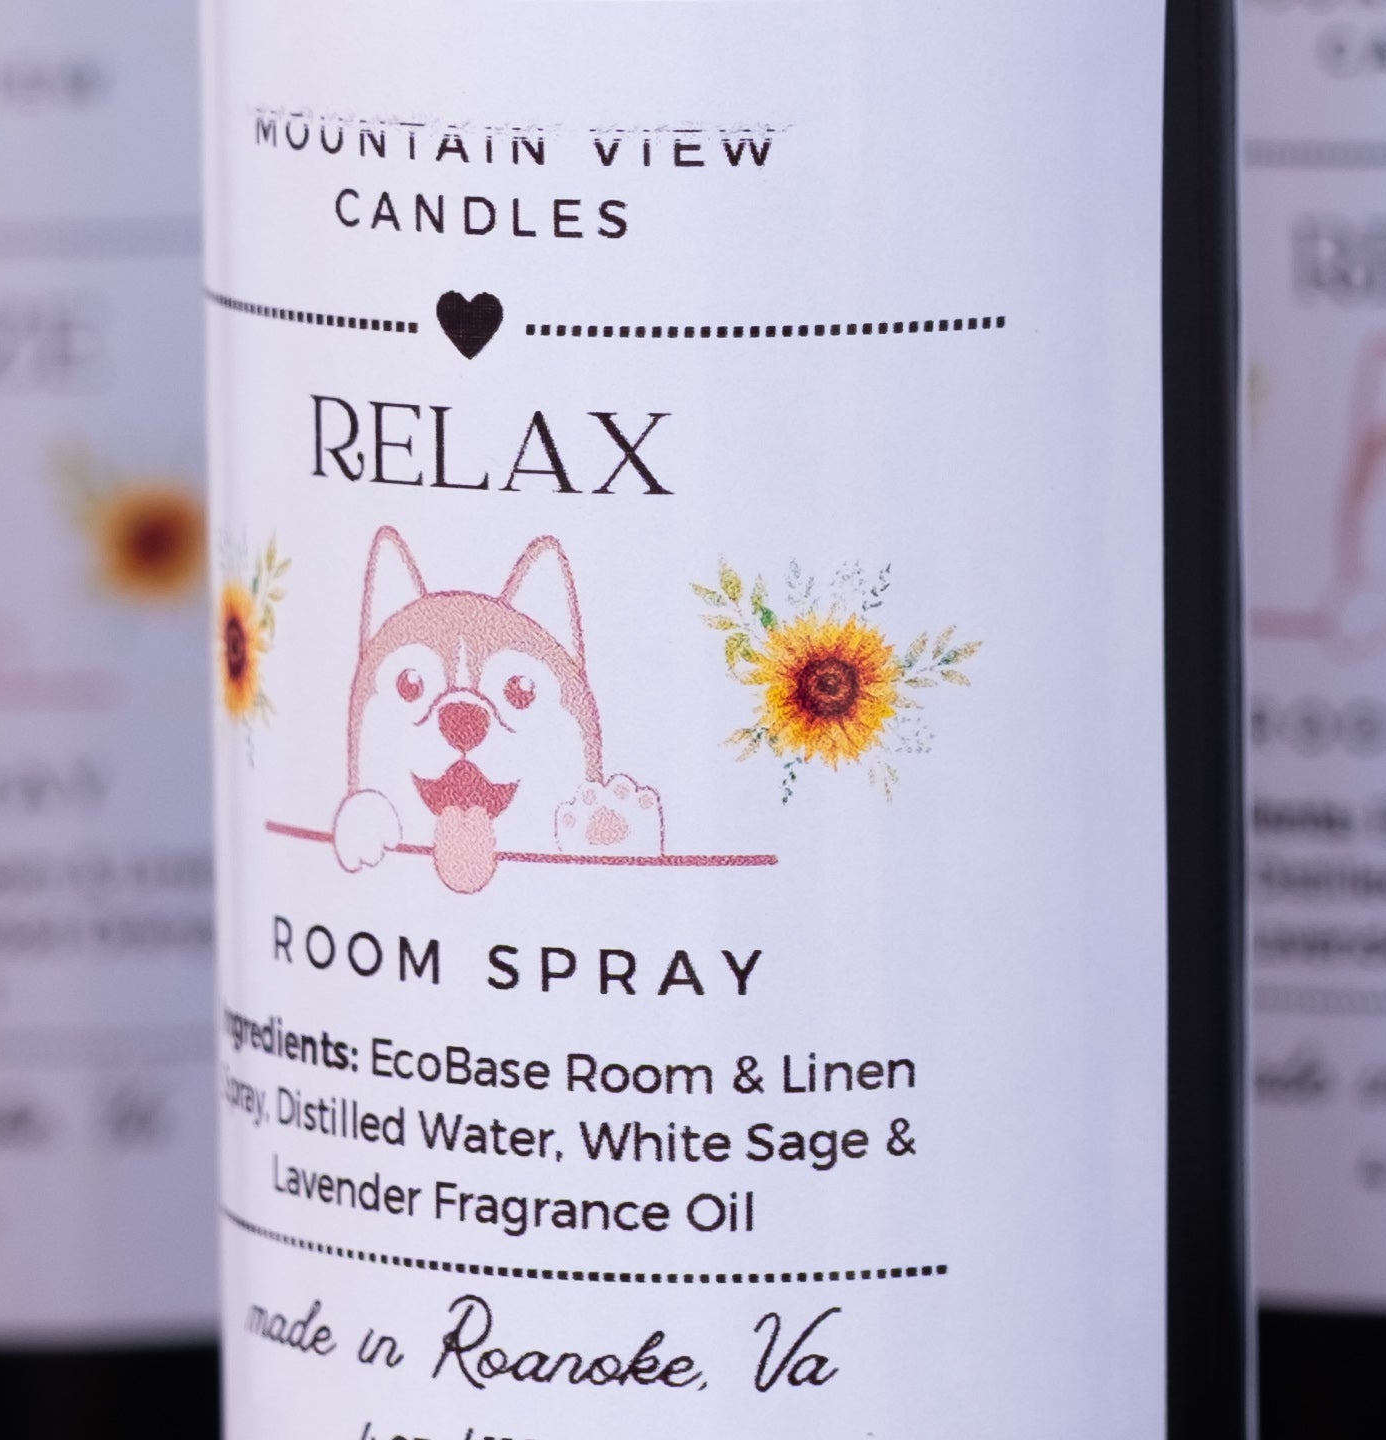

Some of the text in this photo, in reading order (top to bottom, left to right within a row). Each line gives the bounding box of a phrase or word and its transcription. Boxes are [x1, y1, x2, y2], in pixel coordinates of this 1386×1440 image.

[255, 110, 776, 168] MOUNTAIN VIEW
[335, 189, 628, 239] CANDLES
[309, 393, 676, 496] RELAX
[272, 914, 442, 987] ROOM
[487, 944, 764, 997] SPRAY
[370, 1037, 551, 1092] EcoBase
[567, 1051, 714, 1096] Room
[732, 1056, 765, 1095] &
[782, 1049, 917, 1092] Linen
[276, 1085, 405, 1147] Distilled
[418, 1110, 564, 1163] Water,
[579, 1119, 732, 1164] White
[746, 1121, 870, 1171] Sage
[886, 1118, 918, 1158] &
[272, 1152, 756, 1237] Lavender Fragrance Oil
[245, 1292, 843, 1394] made in Roanoke, Va
